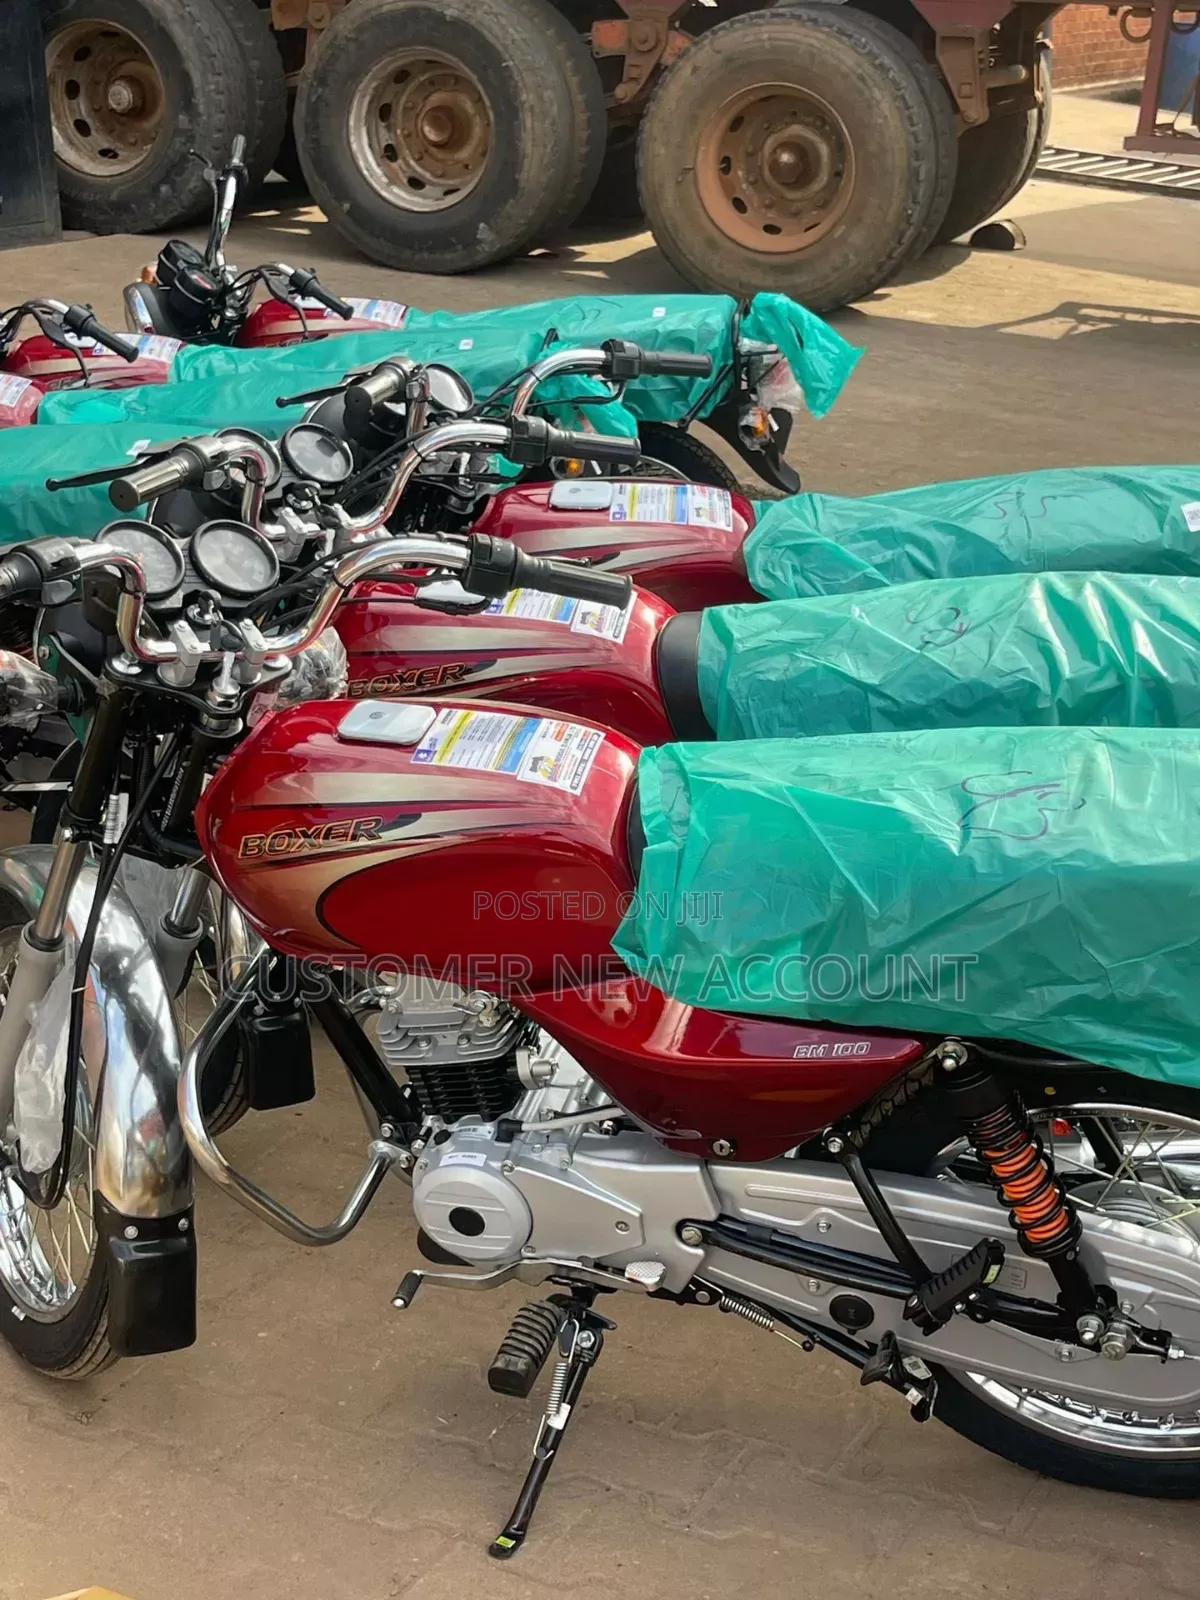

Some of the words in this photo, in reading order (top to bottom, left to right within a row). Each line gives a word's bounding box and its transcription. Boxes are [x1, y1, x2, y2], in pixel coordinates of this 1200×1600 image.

[346, 662, 466, 699] BOXER
[238, 816, 385, 860] BOXER
[792, 1044, 828, 1060] BM
[831, 1041, 871, 1057] 100
